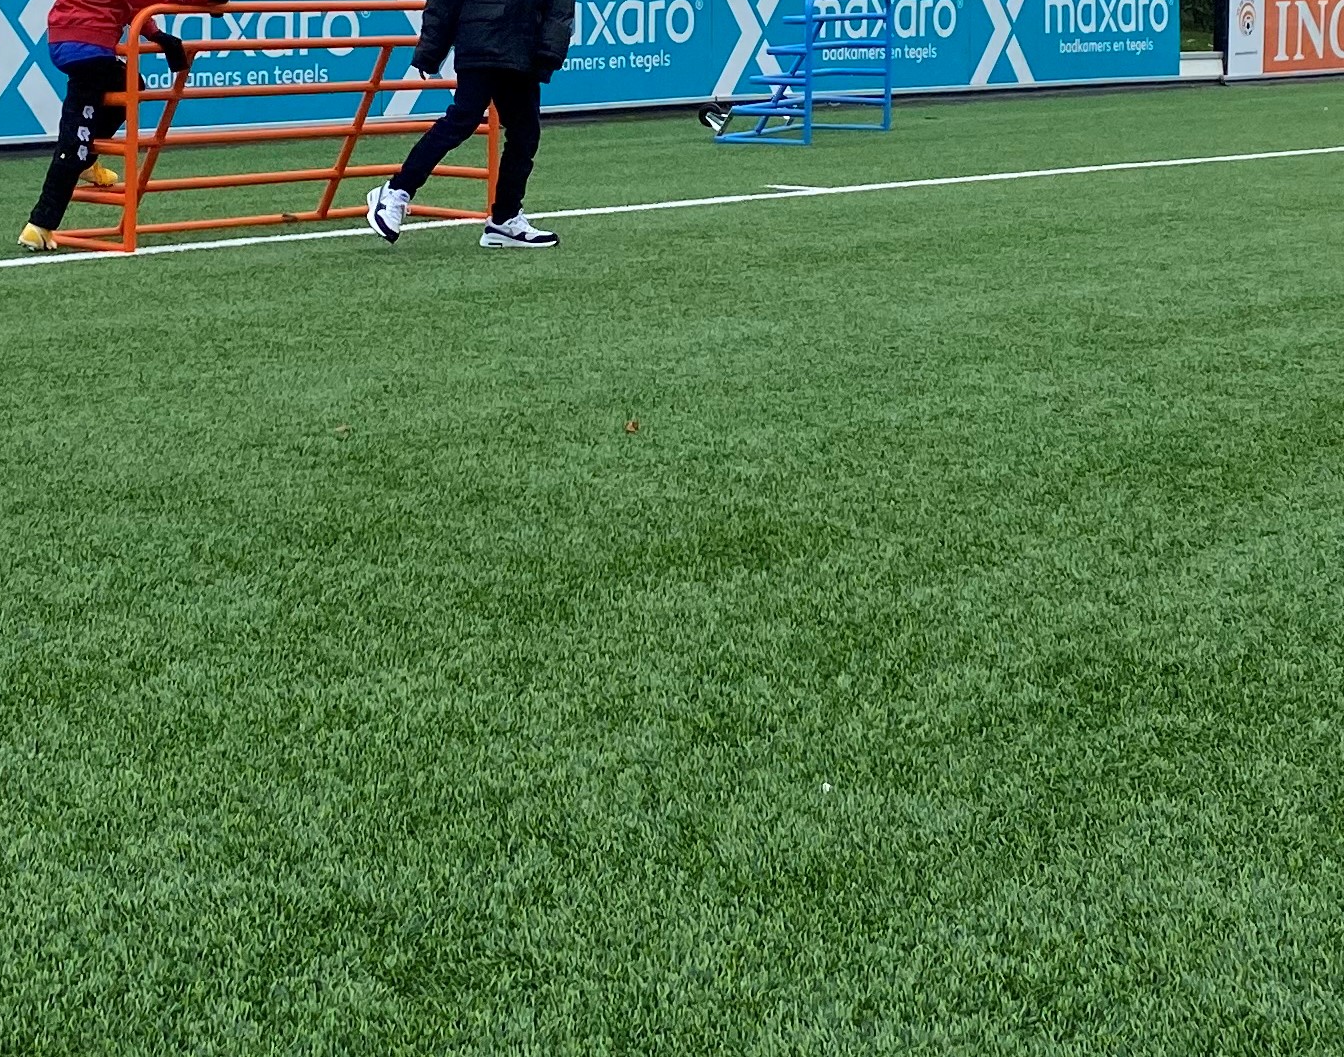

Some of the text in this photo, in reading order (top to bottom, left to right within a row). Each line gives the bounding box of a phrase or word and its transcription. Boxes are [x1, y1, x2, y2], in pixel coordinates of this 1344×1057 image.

[904, 43, 937, 63] tegels
[1059, 37, 1154, 55] badkamers en tegels
[609, 55, 626, 69] en
[630, 49, 671, 72] tegels
[141, 64, 328, 88] adamers en tegels
